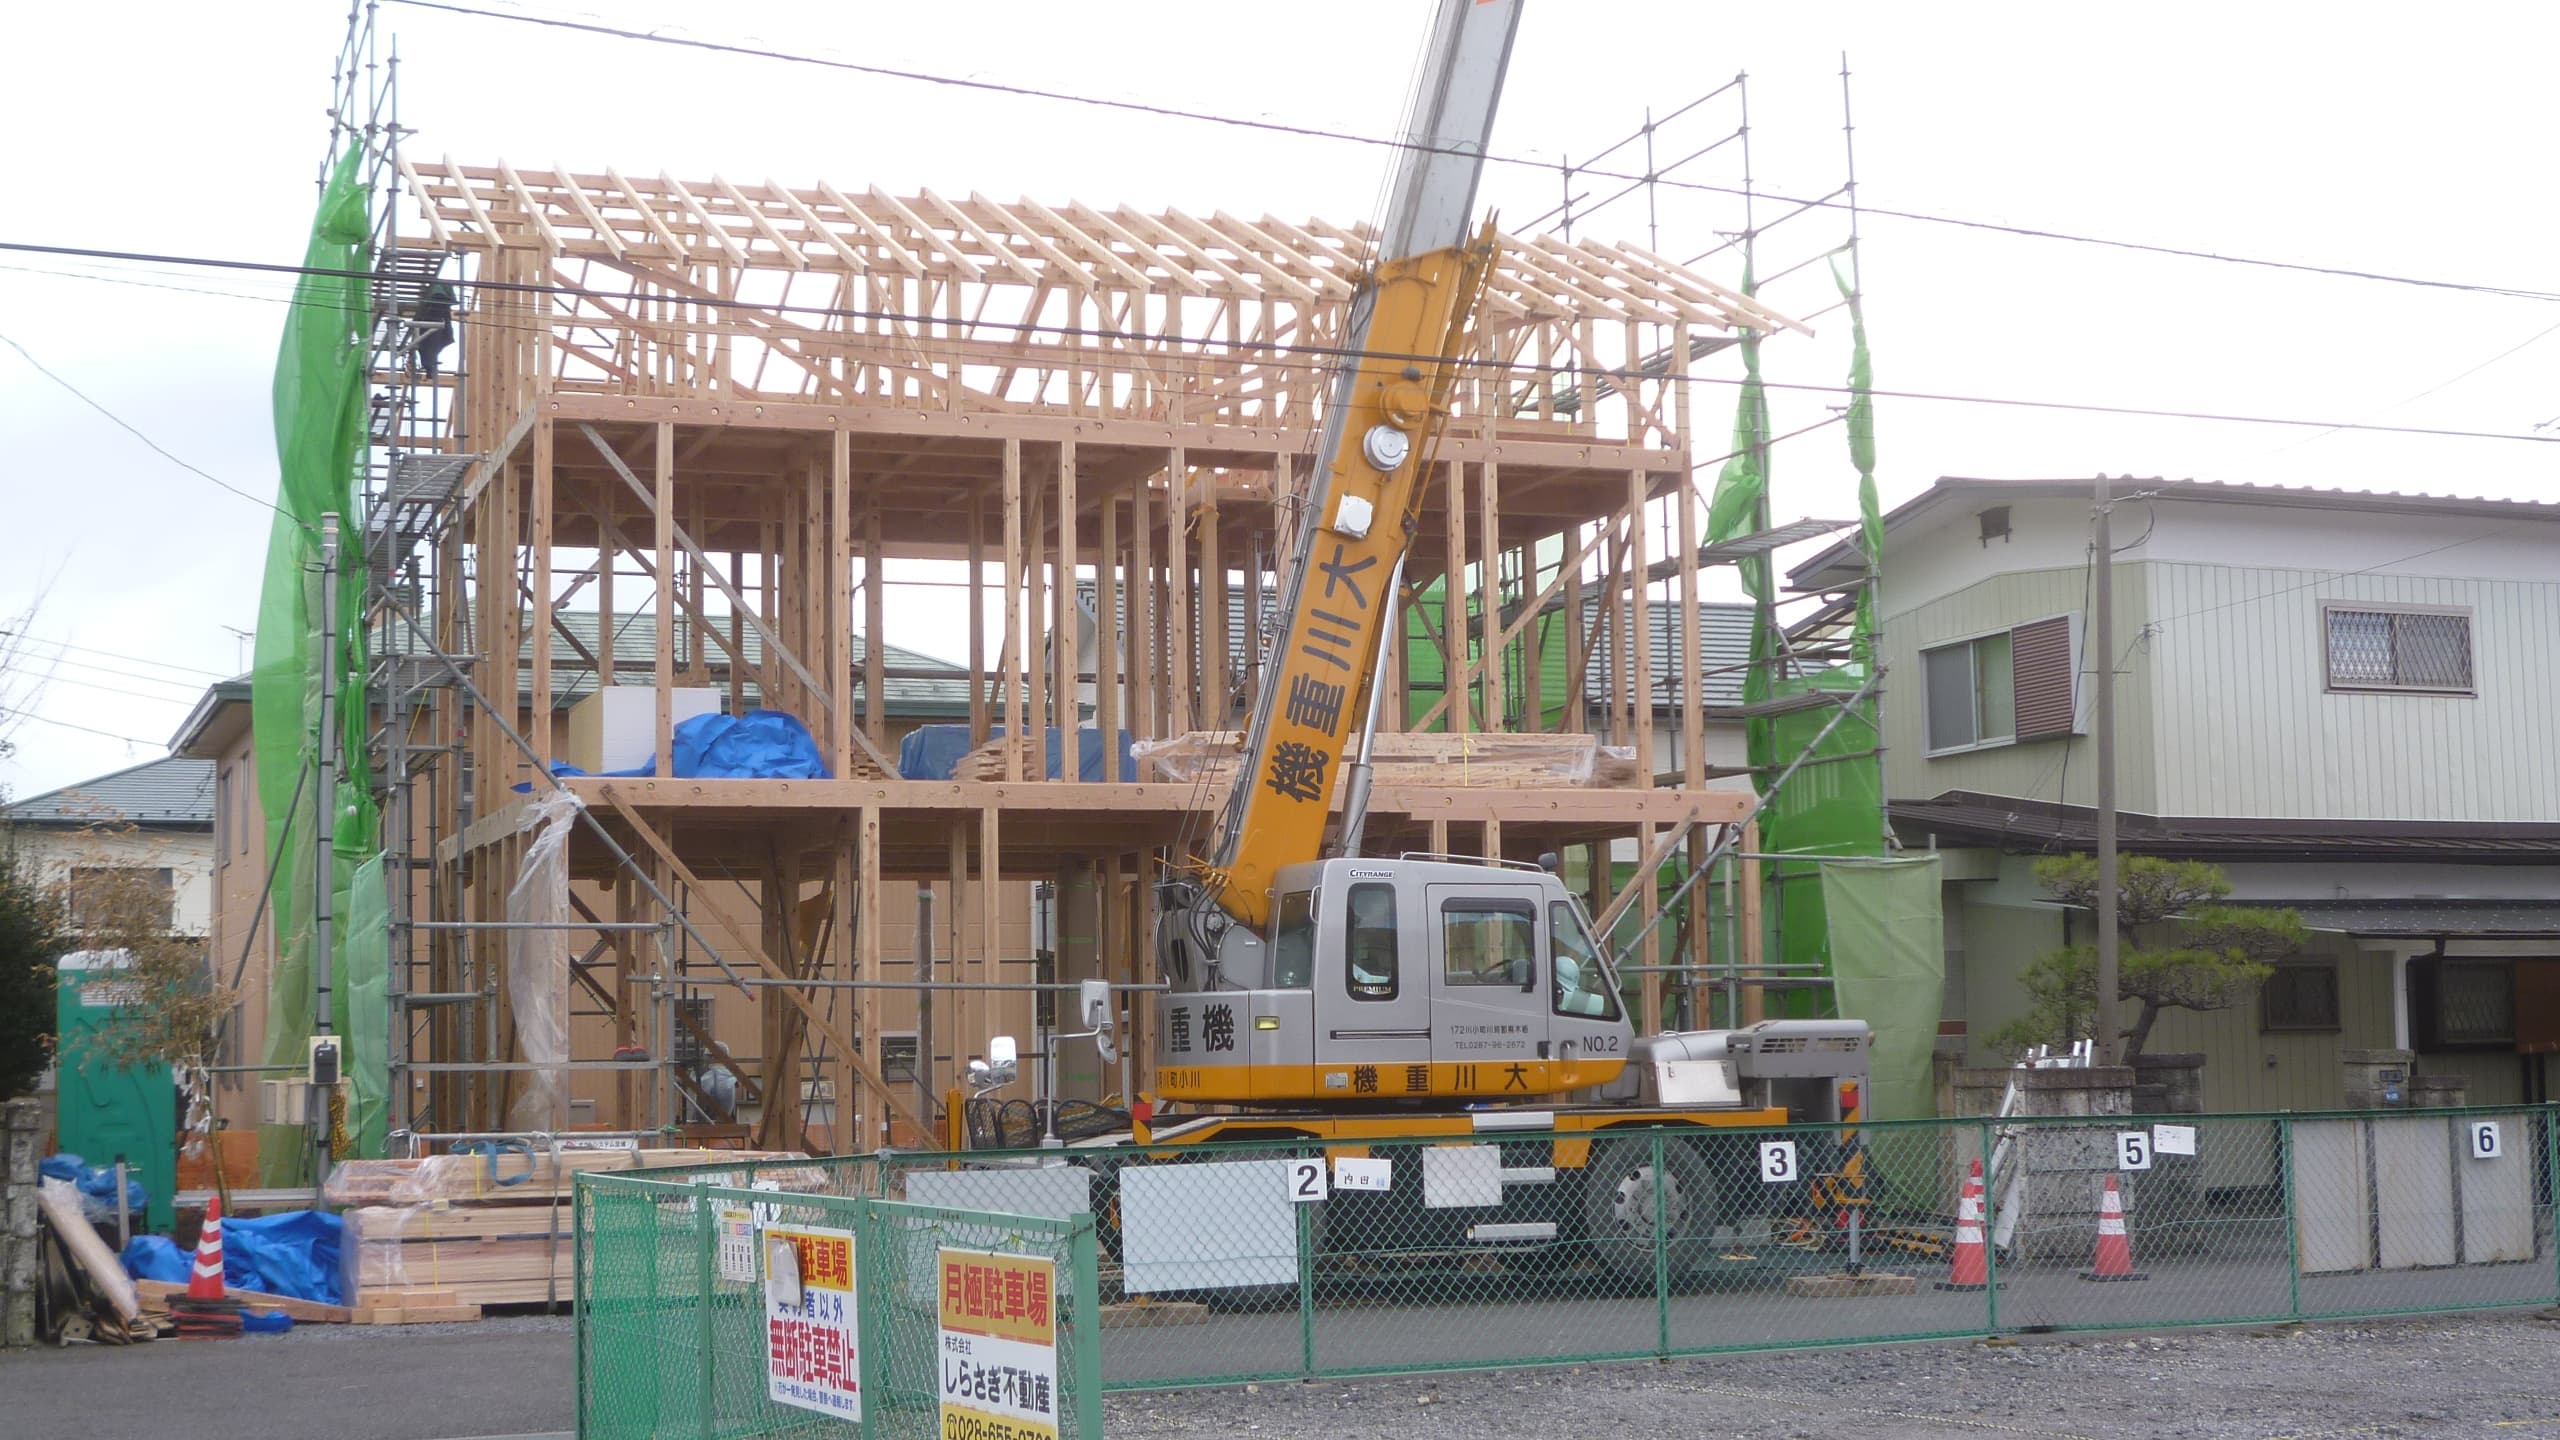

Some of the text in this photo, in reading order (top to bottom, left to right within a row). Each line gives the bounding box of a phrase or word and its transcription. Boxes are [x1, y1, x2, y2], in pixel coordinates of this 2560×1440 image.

[1266, 543, 1379, 803] 大川重機
[1353, 985, 1393, 993] PREMIUM
[1583, 1036, 1618, 1052] NO.2
[2125, 1138, 2143, 1165] 5
[2479, 1125, 2494, 1153] 6
[1768, 1147, 1788, 1177] 3
[1297, 1164, 1319, 1196] 2
[771, 1234, 848, 1287] 駐車場
[945, 1263, 1049, 1327] 月極駐車場
[770, 1315, 857, 1393] 無断駐車禁止
[945, 1336, 972, 1355] 株式会社
[945, 1357, 1051, 1414] しらさぎ不動産
